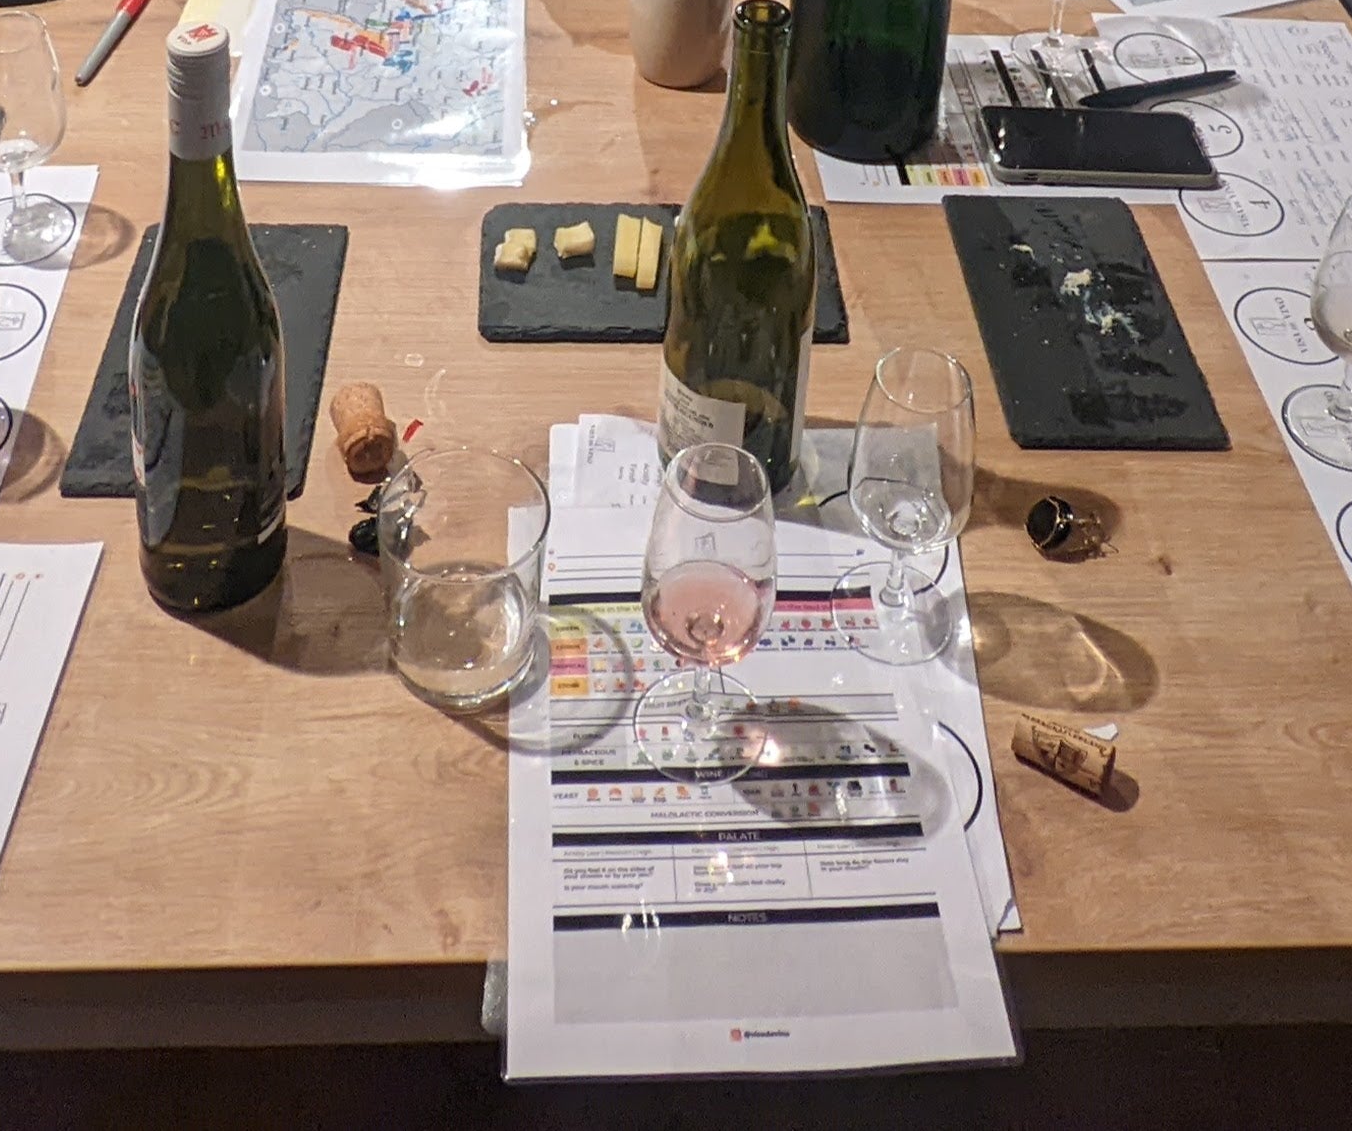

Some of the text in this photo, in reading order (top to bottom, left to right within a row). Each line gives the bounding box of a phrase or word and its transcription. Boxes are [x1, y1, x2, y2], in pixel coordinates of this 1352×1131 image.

[1208, 125, 1232, 134] 5
[1249, 200, 1270, 209] 4
[649, 809, 704, 820] MALOLACTIC
[717, 830, 761, 842] PALATE
[727, 912, 769, 925] NOTES
